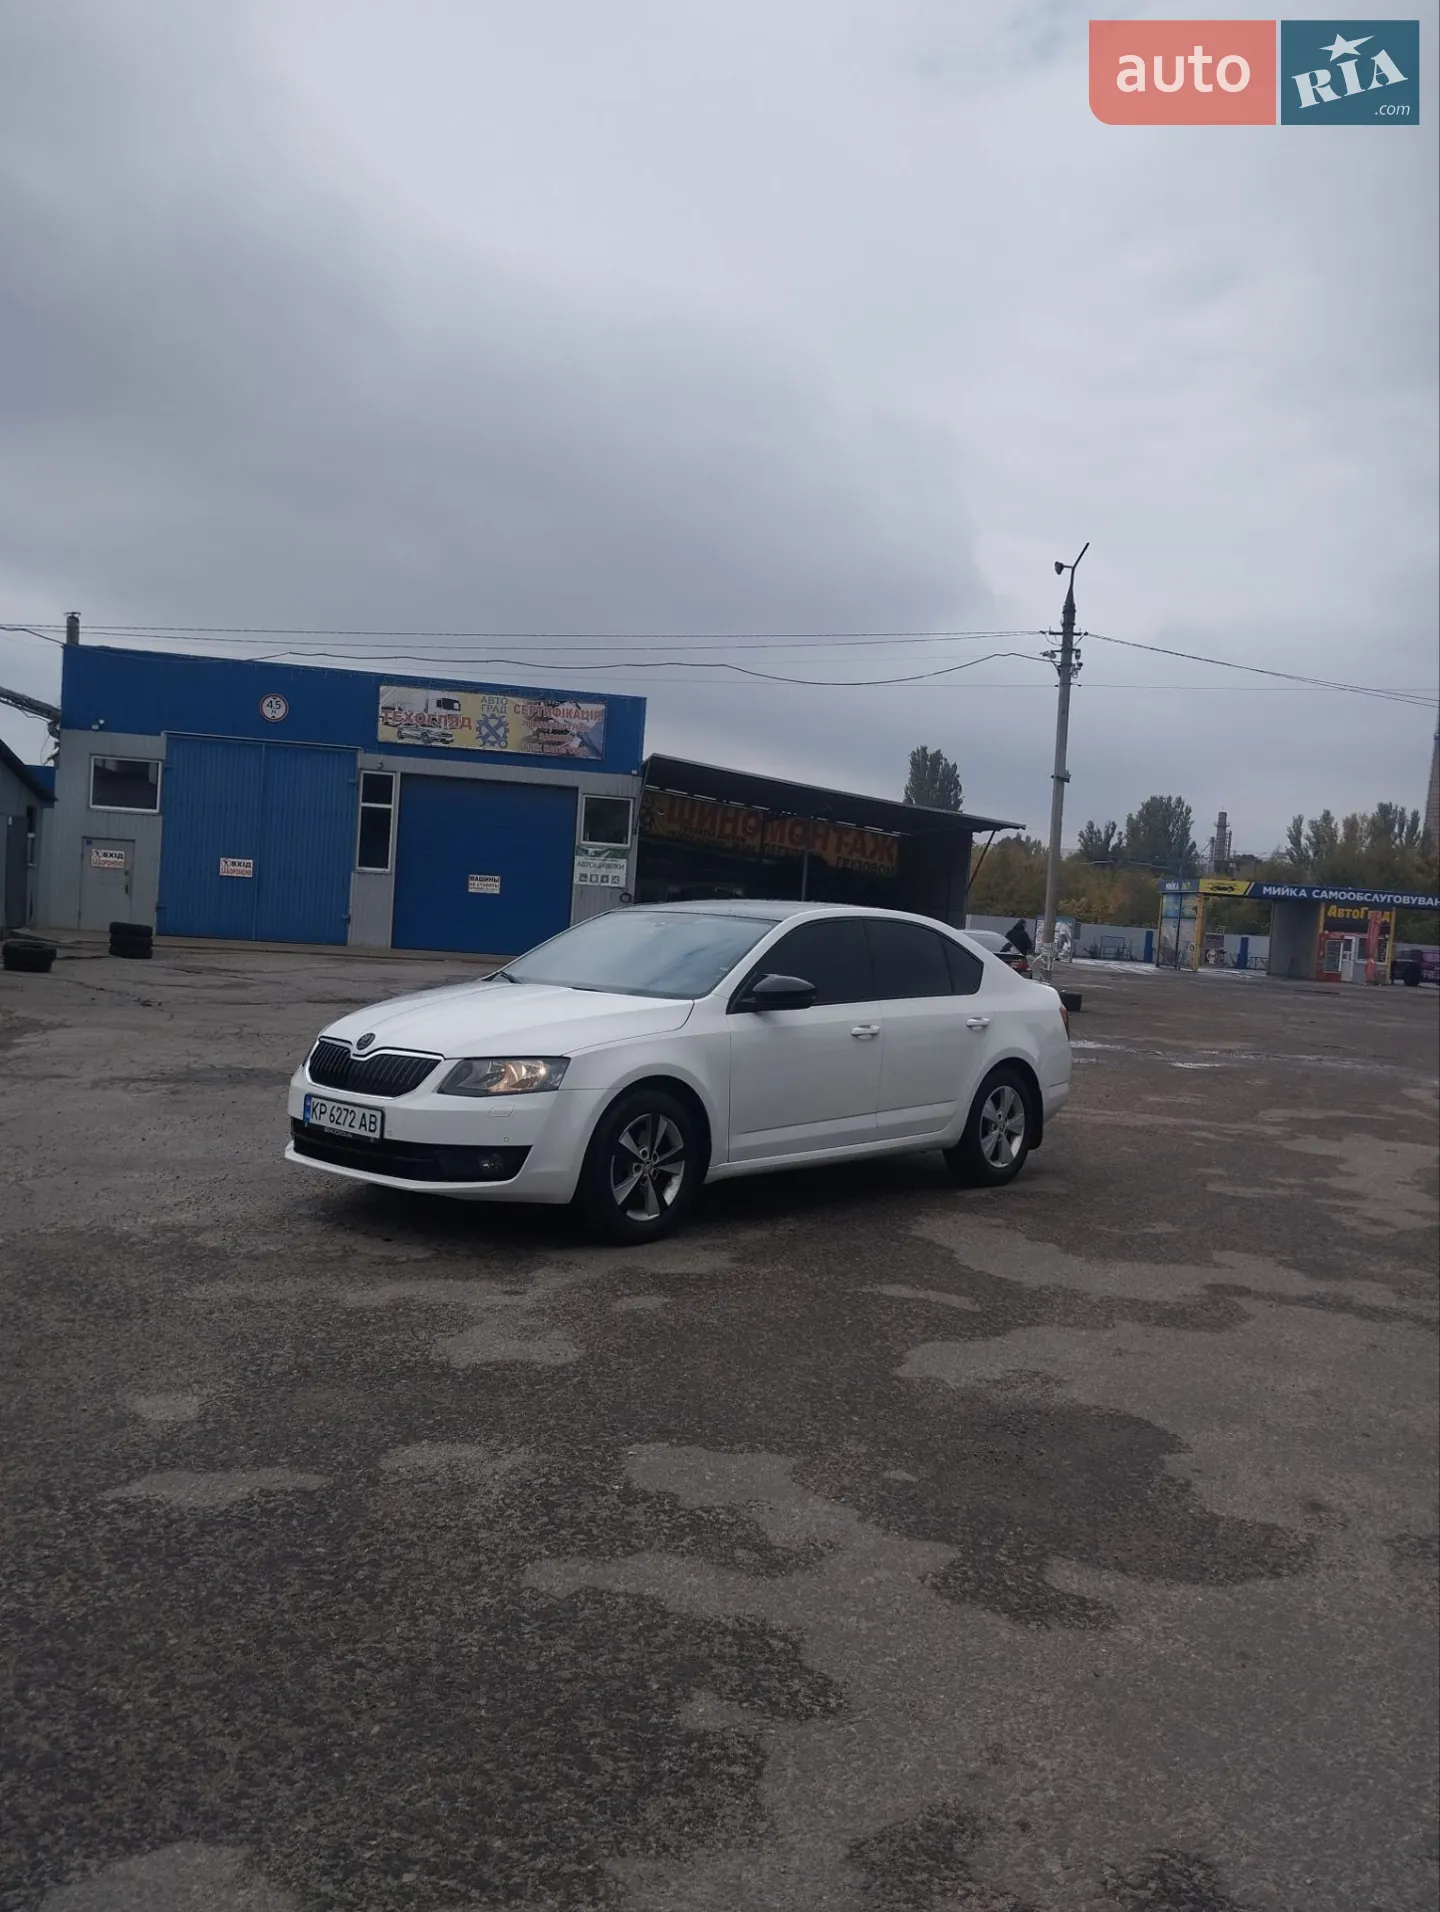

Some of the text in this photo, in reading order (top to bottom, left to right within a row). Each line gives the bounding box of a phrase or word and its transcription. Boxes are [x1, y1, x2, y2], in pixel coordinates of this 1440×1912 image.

[480, 696, 508, 706] АВТО
[481, 704, 507, 714] ГРАД
[513, 704, 601, 722] СЕРТИФІКАЦІЯ
[382, 710, 472, 730] ТЕХОГЛЯД
[231, 860, 252, 868] ВХІД
[1262, 885, 1308, 898] МИЙКА
[311, 1101, 378, 1133] KP 6272 AB
